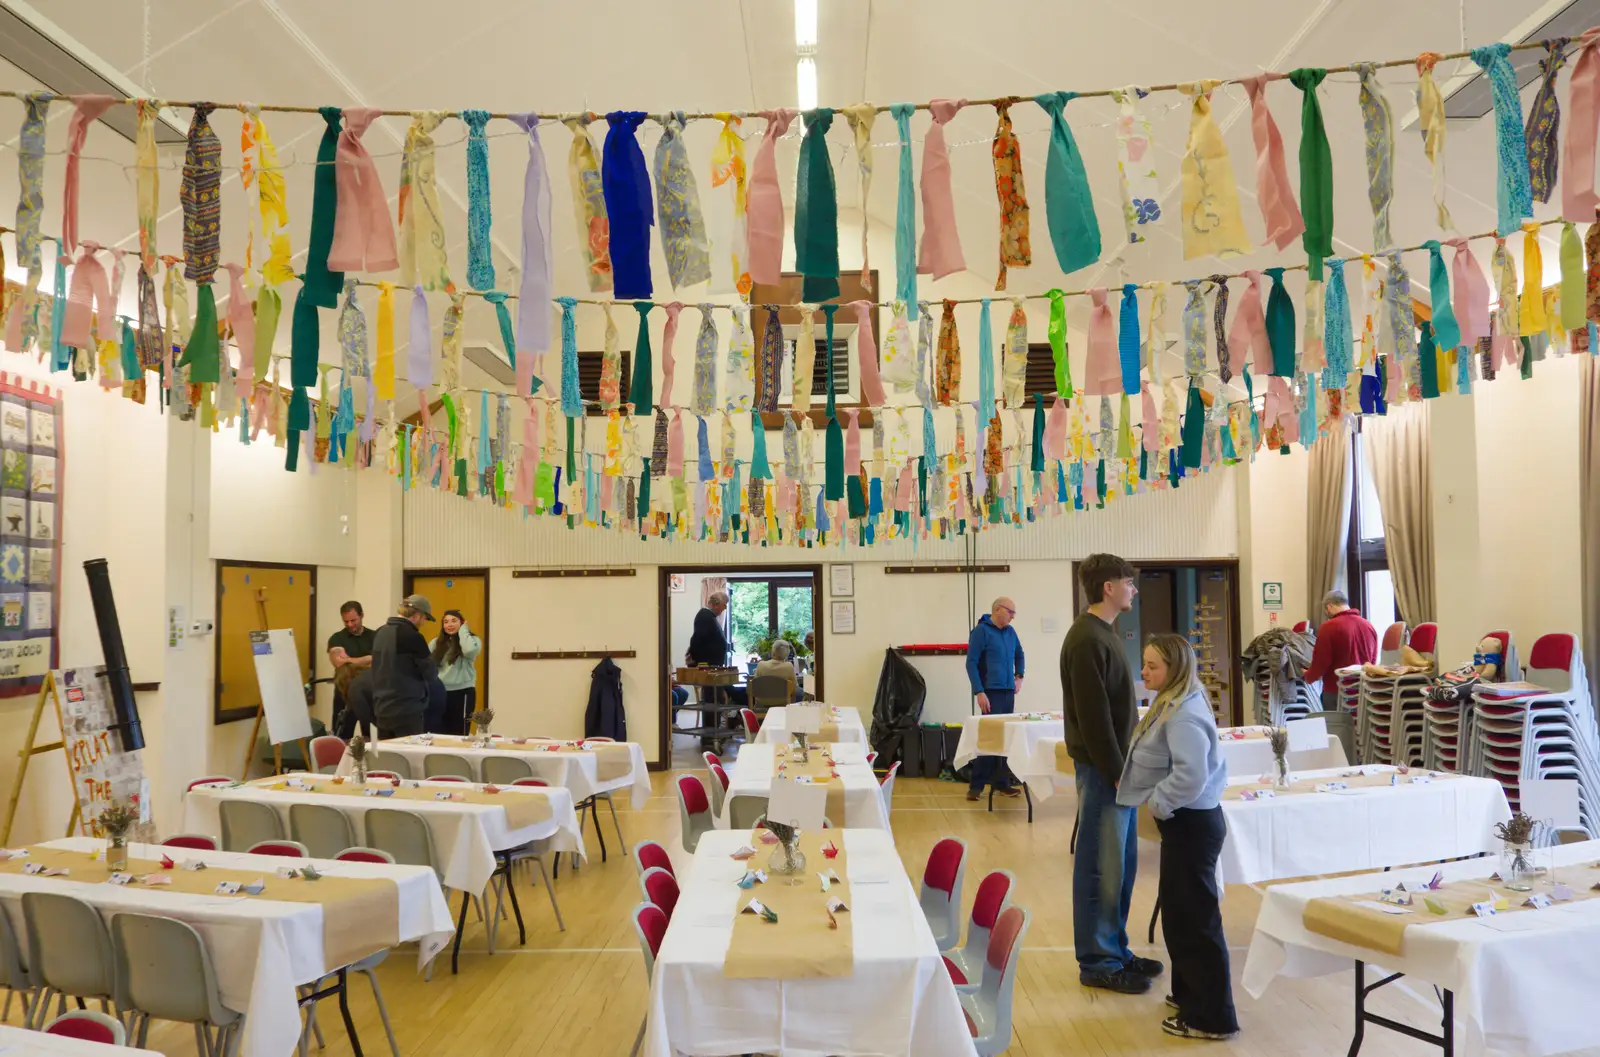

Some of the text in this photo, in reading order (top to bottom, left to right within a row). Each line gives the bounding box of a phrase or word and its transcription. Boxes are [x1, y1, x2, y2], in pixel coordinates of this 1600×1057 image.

[16, 644, 42, 658] 2000
[73, 731, 110, 773] SPLAT
[84, 778, 111, 802] THE
